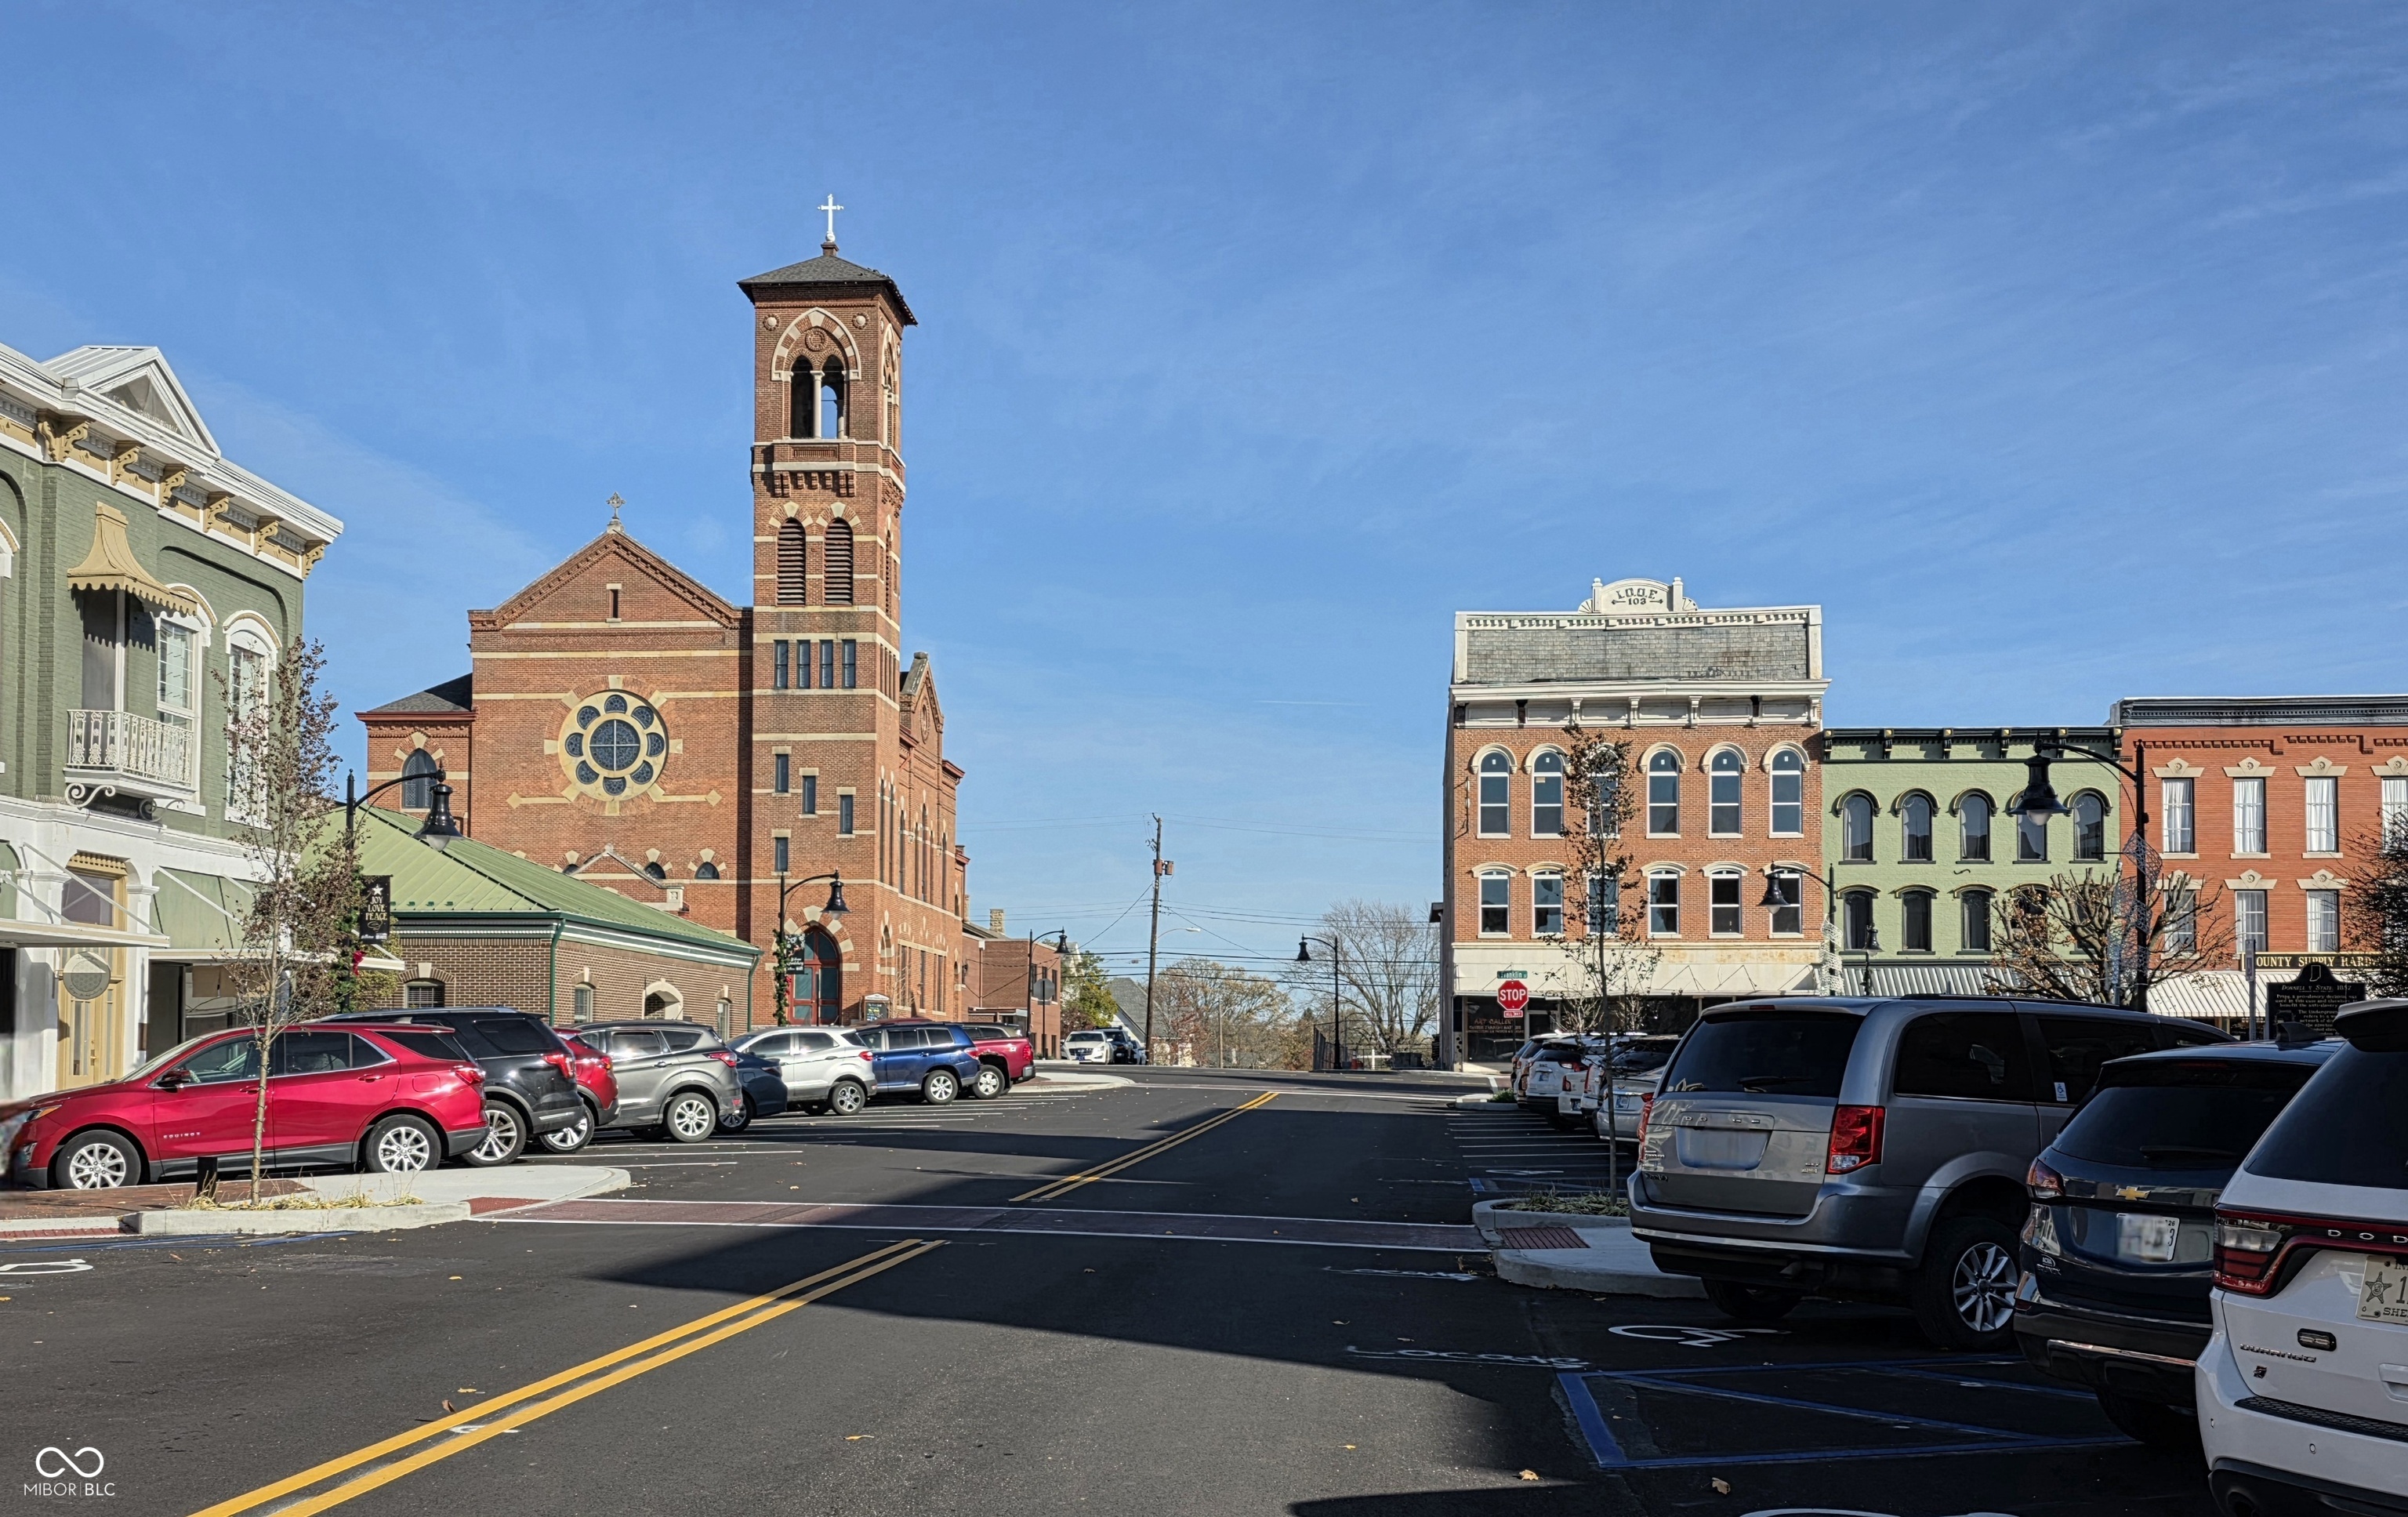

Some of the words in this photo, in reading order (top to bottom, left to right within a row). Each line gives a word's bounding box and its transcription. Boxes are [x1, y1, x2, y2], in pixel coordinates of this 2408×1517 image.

[370, 896, 383, 905] JOY
[368, 904, 386, 913] LOVE
[365, 912, 387, 920] PEACE
[2256, 956, 2291, 967] OUNTY
[2298, 956, 2335, 967] SUPPLY
[1500, 989, 1526, 1001] STOP
[2239, 1343, 2317, 1363] DURANGO
